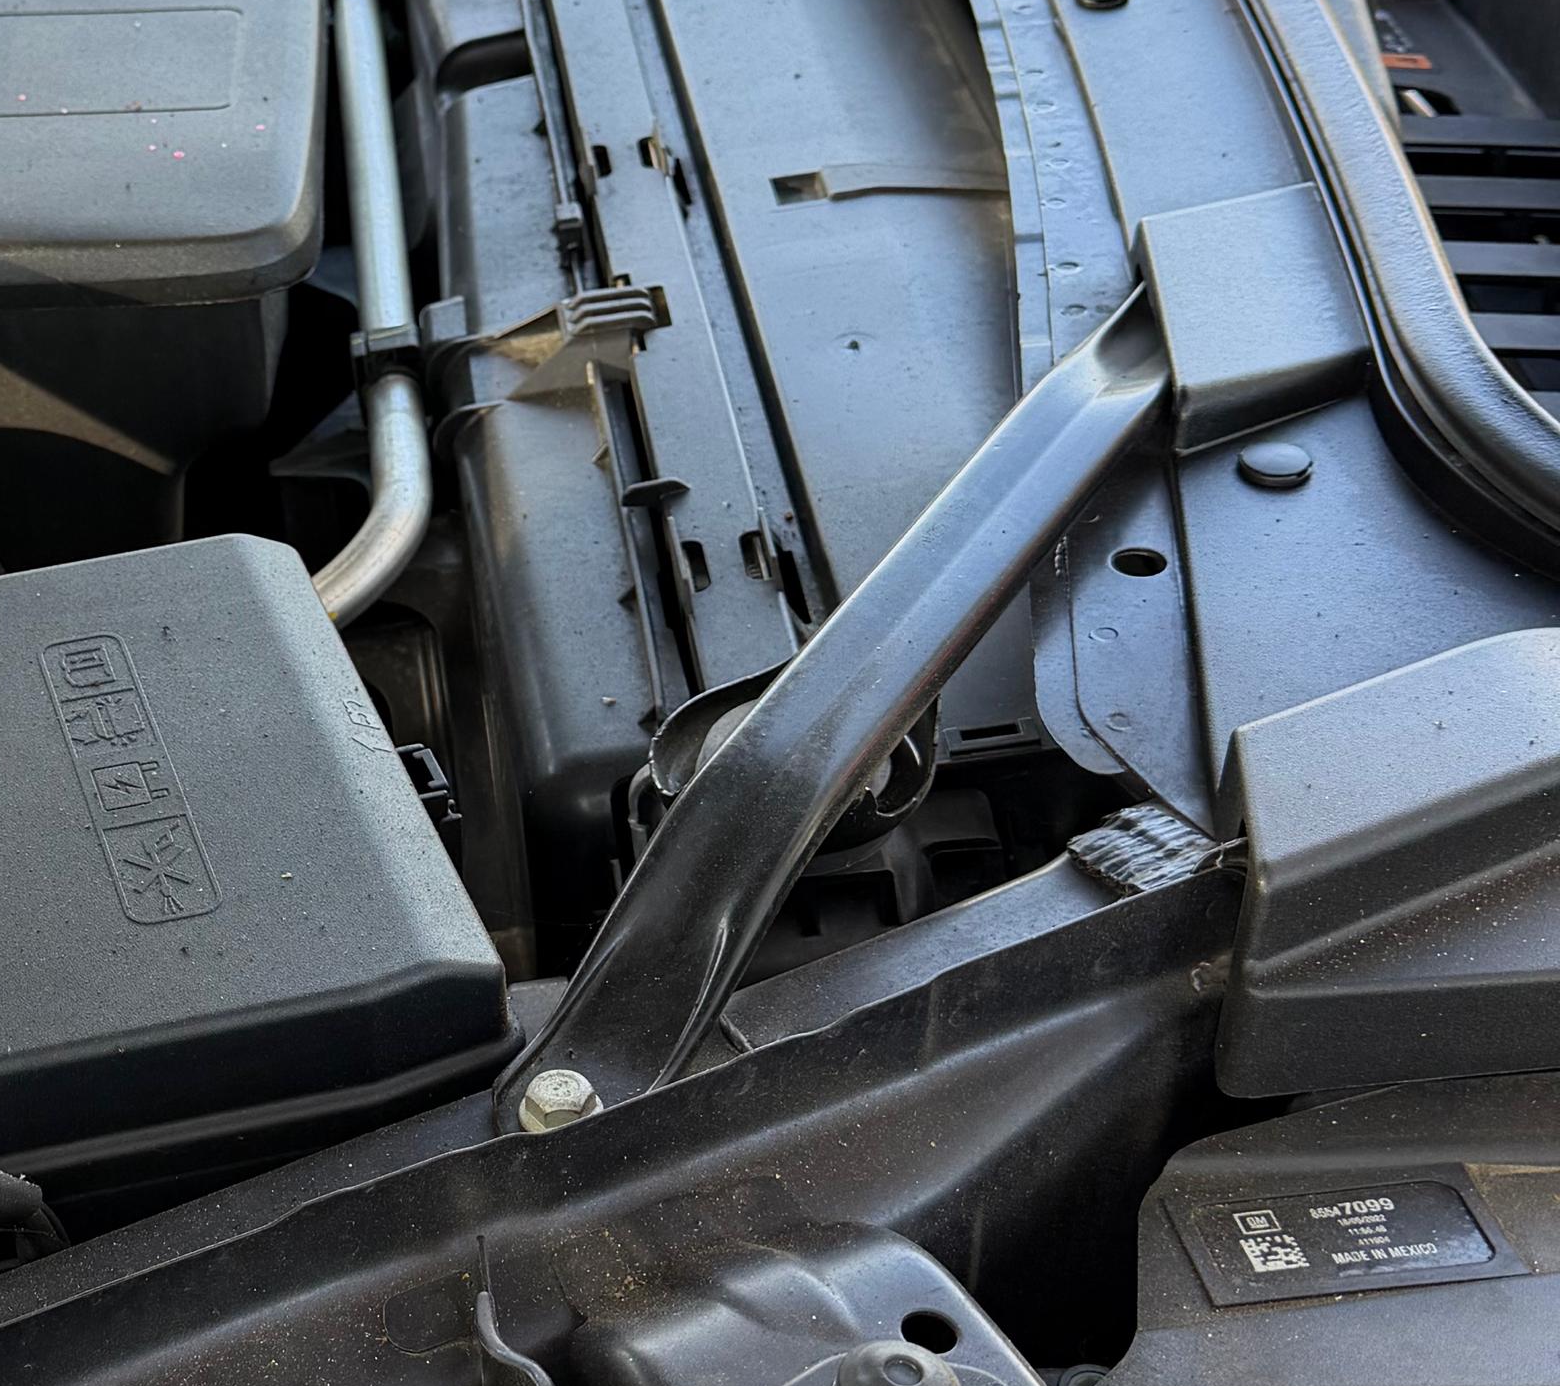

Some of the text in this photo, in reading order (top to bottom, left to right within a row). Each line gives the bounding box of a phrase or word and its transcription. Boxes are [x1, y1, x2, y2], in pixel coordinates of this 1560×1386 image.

[1246, 1215, 1270, 1229] GM
[1331, 1242, 1438, 1265] MADE IN MEXICO
